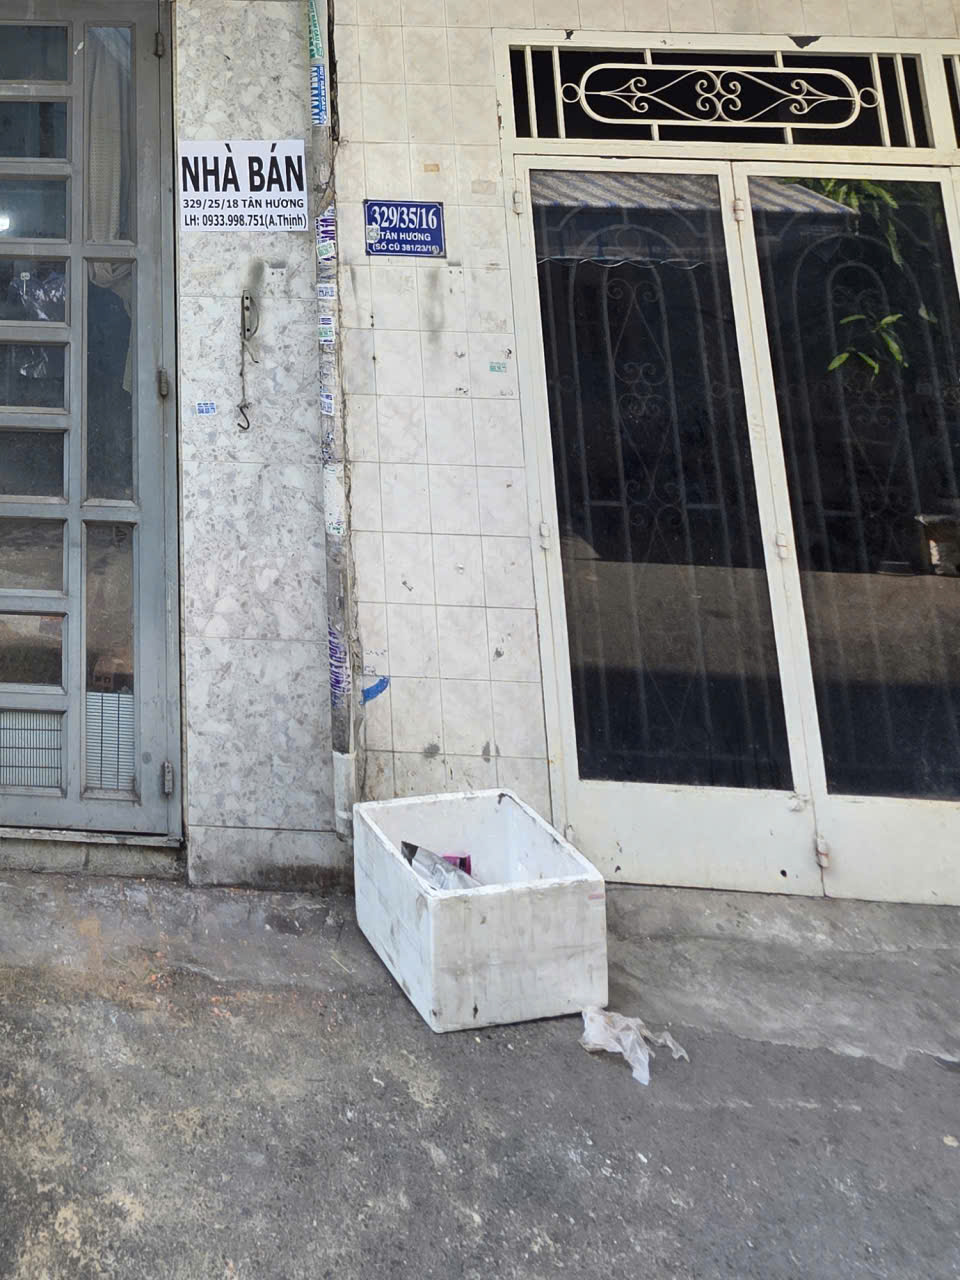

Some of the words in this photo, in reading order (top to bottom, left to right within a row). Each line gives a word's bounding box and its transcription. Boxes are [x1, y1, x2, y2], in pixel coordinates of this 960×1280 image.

[181, 143, 240, 192] NHÀ
[248, 143, 304, 192] BÁN
[183, 198, 239, 210] 329/25/18
[242, 196, 262, 208] TÂN
[265, 197, 304, 209] HƯƠNG
[184, 215, 200, 227] LH:
[371, 205, 437, 229] 329/35/16
[380, 230, 397, 240] TÂN
[400, 231, 431, 241] HƯƠNG
[372, 241, 387, 251] (SỐ
[388, 242, 400, 251] CŨ
